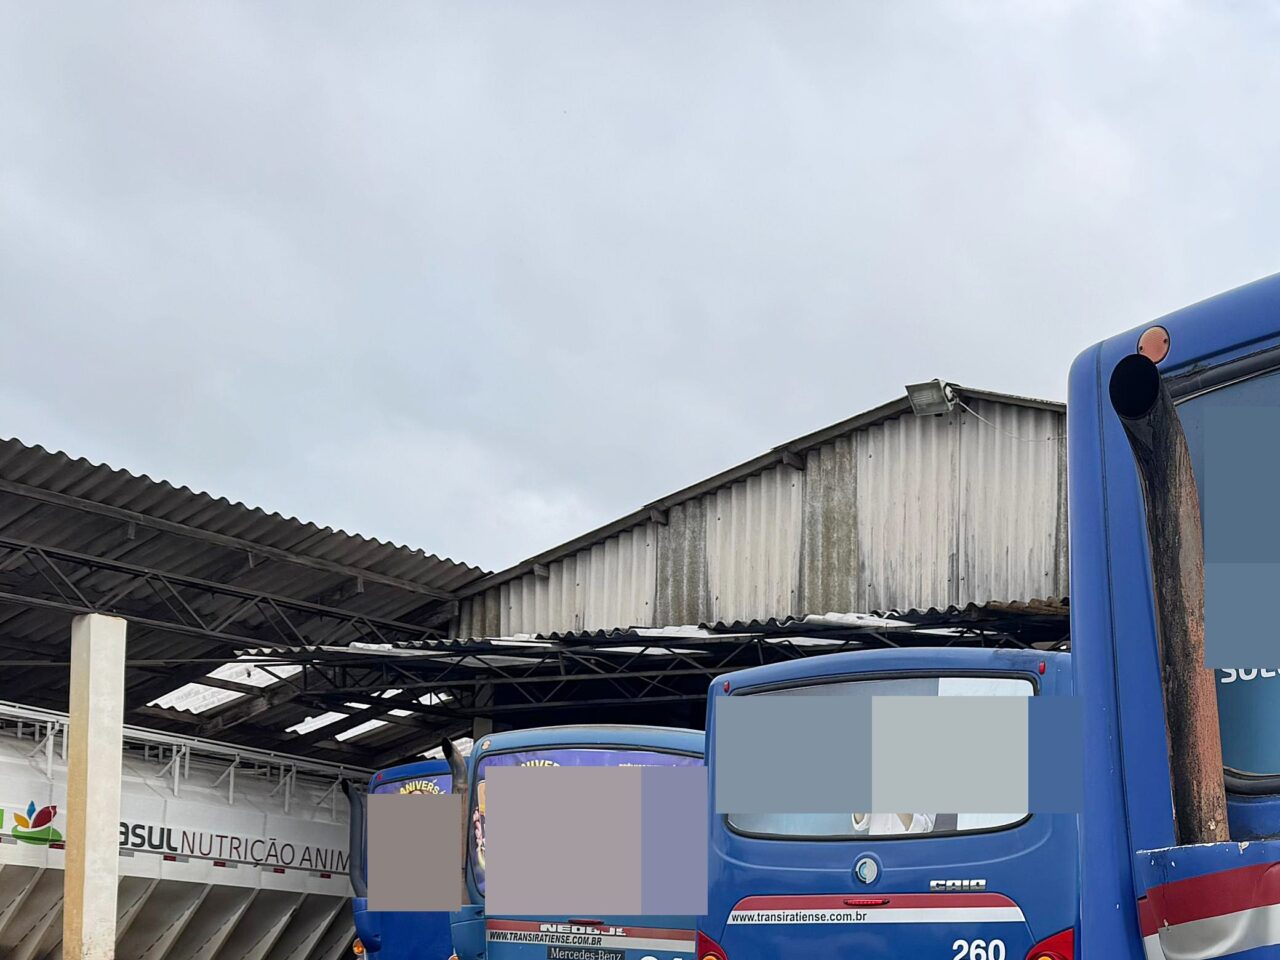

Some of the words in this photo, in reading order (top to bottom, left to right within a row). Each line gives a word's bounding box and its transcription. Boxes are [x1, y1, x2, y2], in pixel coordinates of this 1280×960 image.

[181, 830, 295, 868] NUTRIÇÃO
[731, 911, 867, 923] www.transiratiense.com.br
[489, 931, 603, 946] WWW.TRANSIRATIENSE.COM.BR
